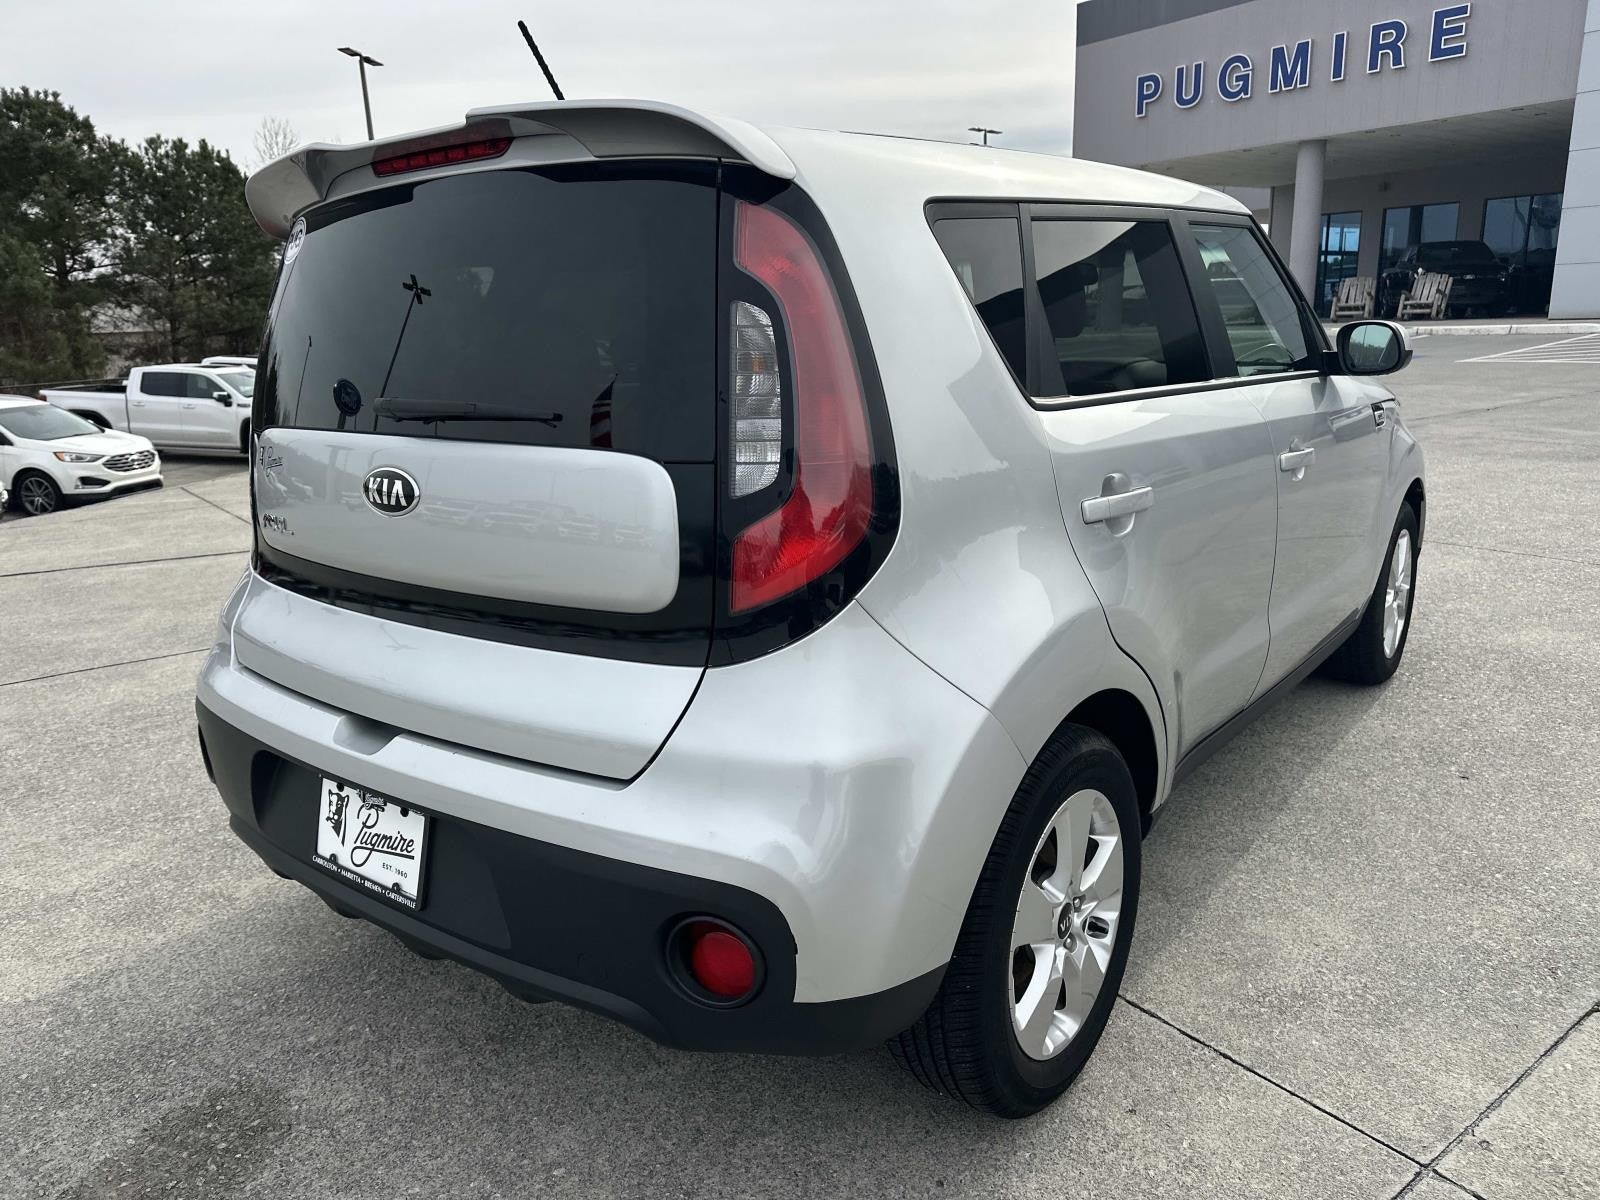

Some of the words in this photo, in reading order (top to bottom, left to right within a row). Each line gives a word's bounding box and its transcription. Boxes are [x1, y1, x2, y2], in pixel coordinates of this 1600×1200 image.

[1135, 2, 1471, 118] PUGMIRE
[368, 476, 408, 507] KIA
[351, 803, 415, 867] Pugmire
[382, 862, 393, 872] EST.
[385, 890, 417, 909] CARTERSVILLE
